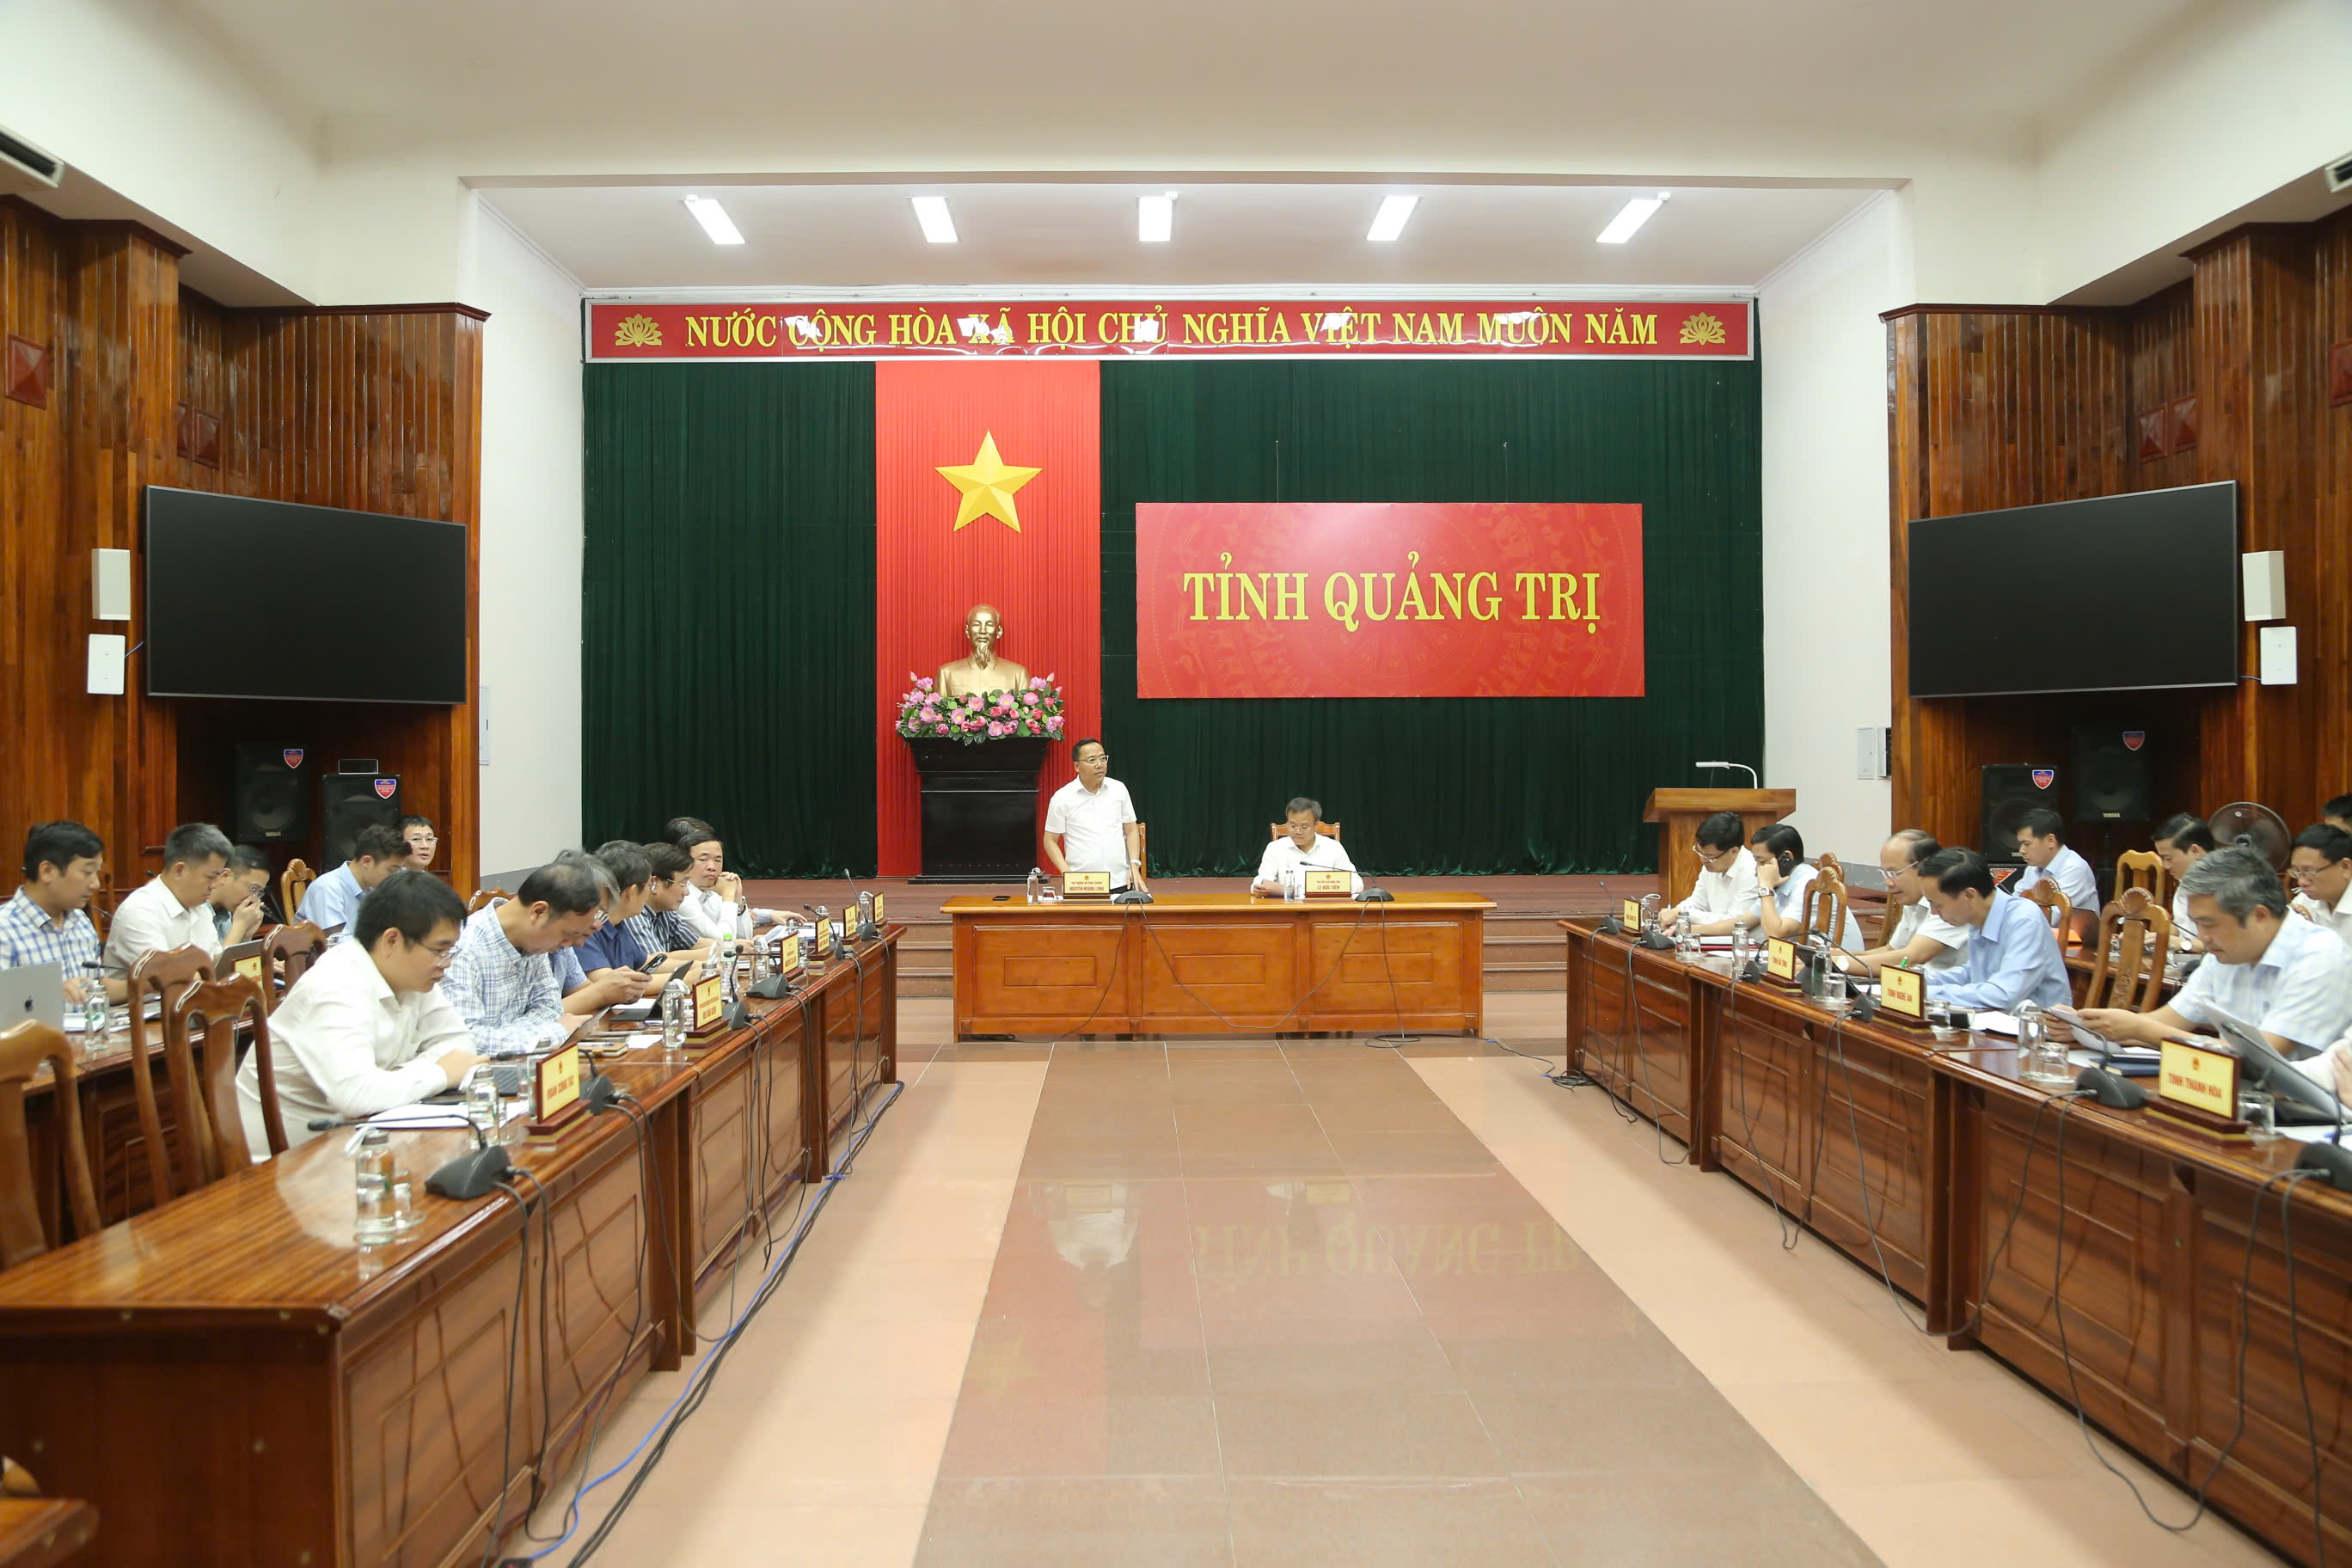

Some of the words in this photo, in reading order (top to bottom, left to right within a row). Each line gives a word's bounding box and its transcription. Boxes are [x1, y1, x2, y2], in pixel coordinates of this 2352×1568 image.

[685, 307, 777, 347] NƯỚC
[788, 309, 877, 352] CỘNG
[888, 307, 957, 346] HÒA
[1026, 305, 1087, 351] HỘI
[1098, 304, 1168, 344] CHỦ
[1182, 306, 1292, 345] NGHĨA
[1300, 305, 1381, 350] VIỆT
[1393, 313, 1466, 344] NAM
[1476, 306, 1573, 345] MUÔN
[1584, 307, 1658, 345] NĂM
[1183, 551, 1309, 621] TỈNH
[1324, 550, 1503, 634] QUẢNG
[1515, 571, 1601, 634] TRỊ
